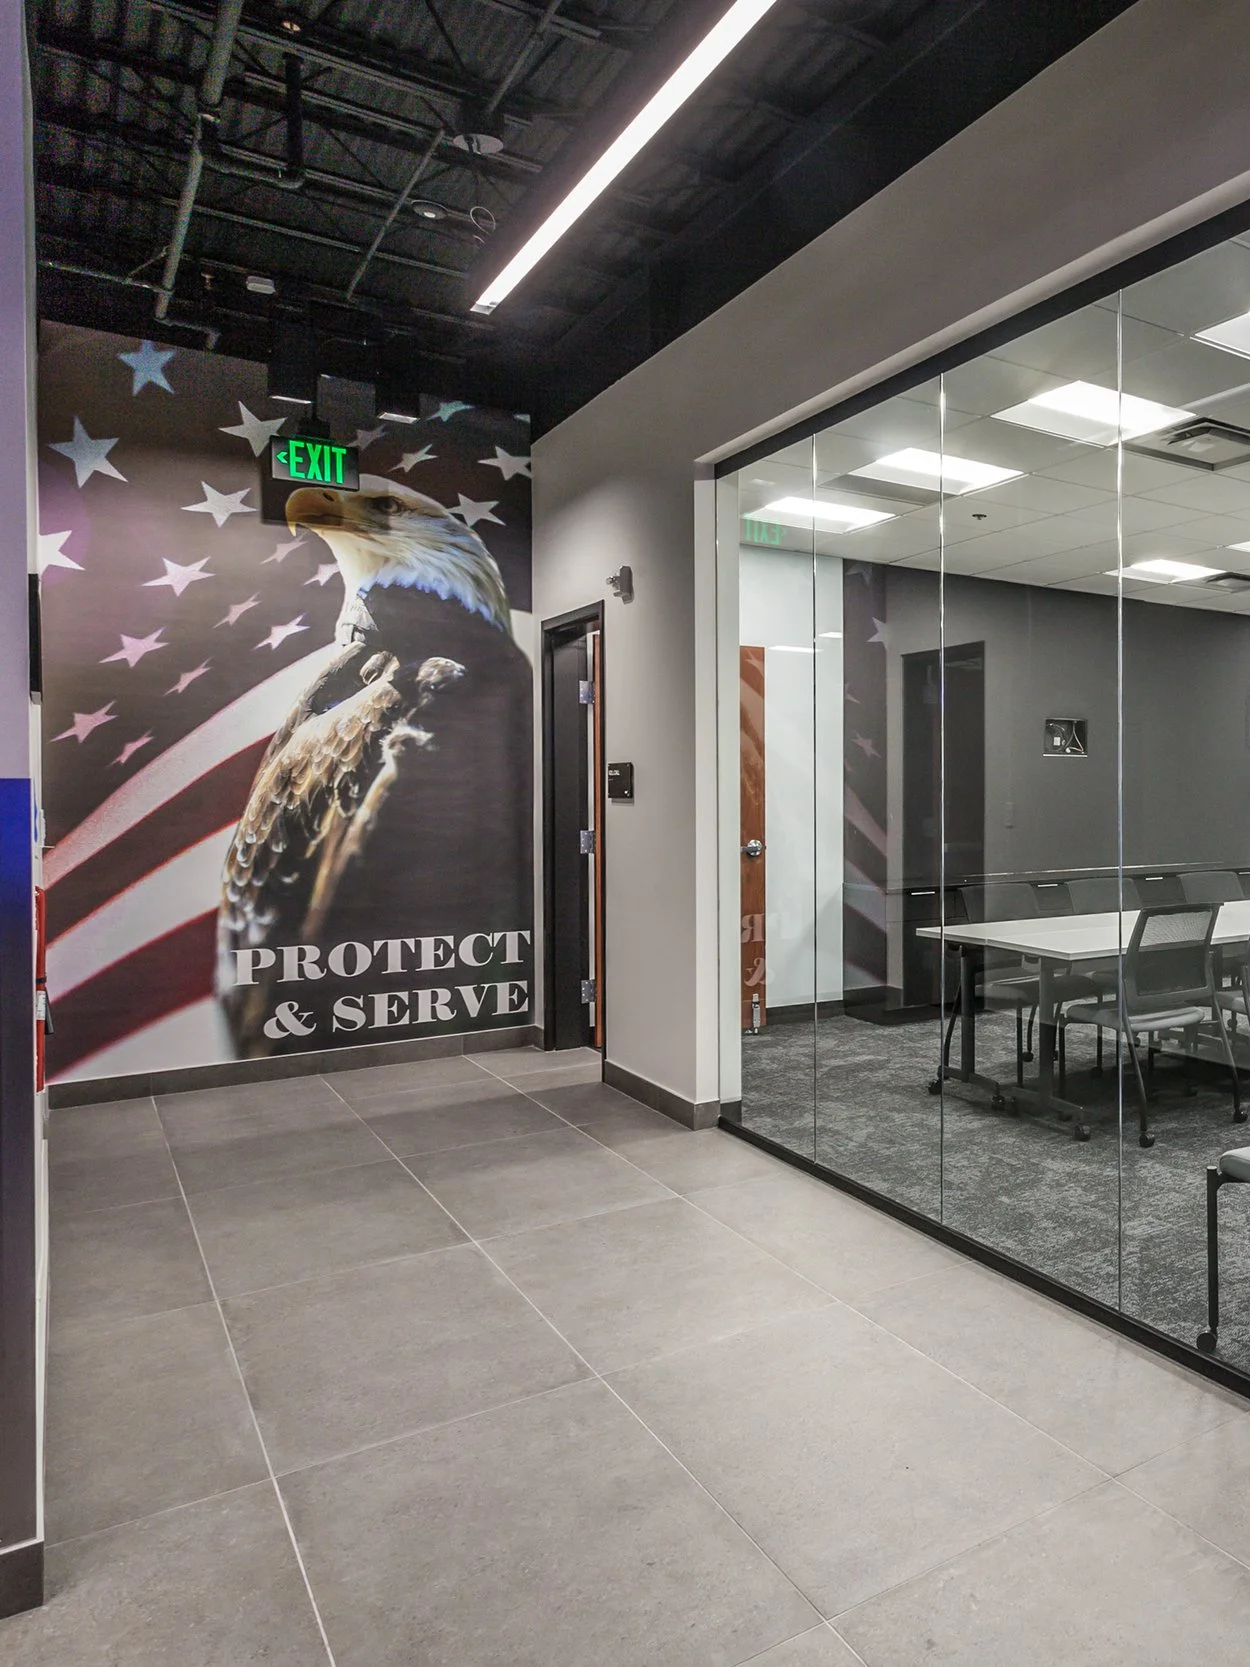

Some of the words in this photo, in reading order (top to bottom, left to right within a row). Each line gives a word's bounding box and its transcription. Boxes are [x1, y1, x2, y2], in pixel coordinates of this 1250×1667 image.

[289, 440, 347, 484] EXIT
[231, 930, 531, 986] PROTECT
[263, 1000, 317, 1040] &
[332, 980, 529, 1033] SERVE
